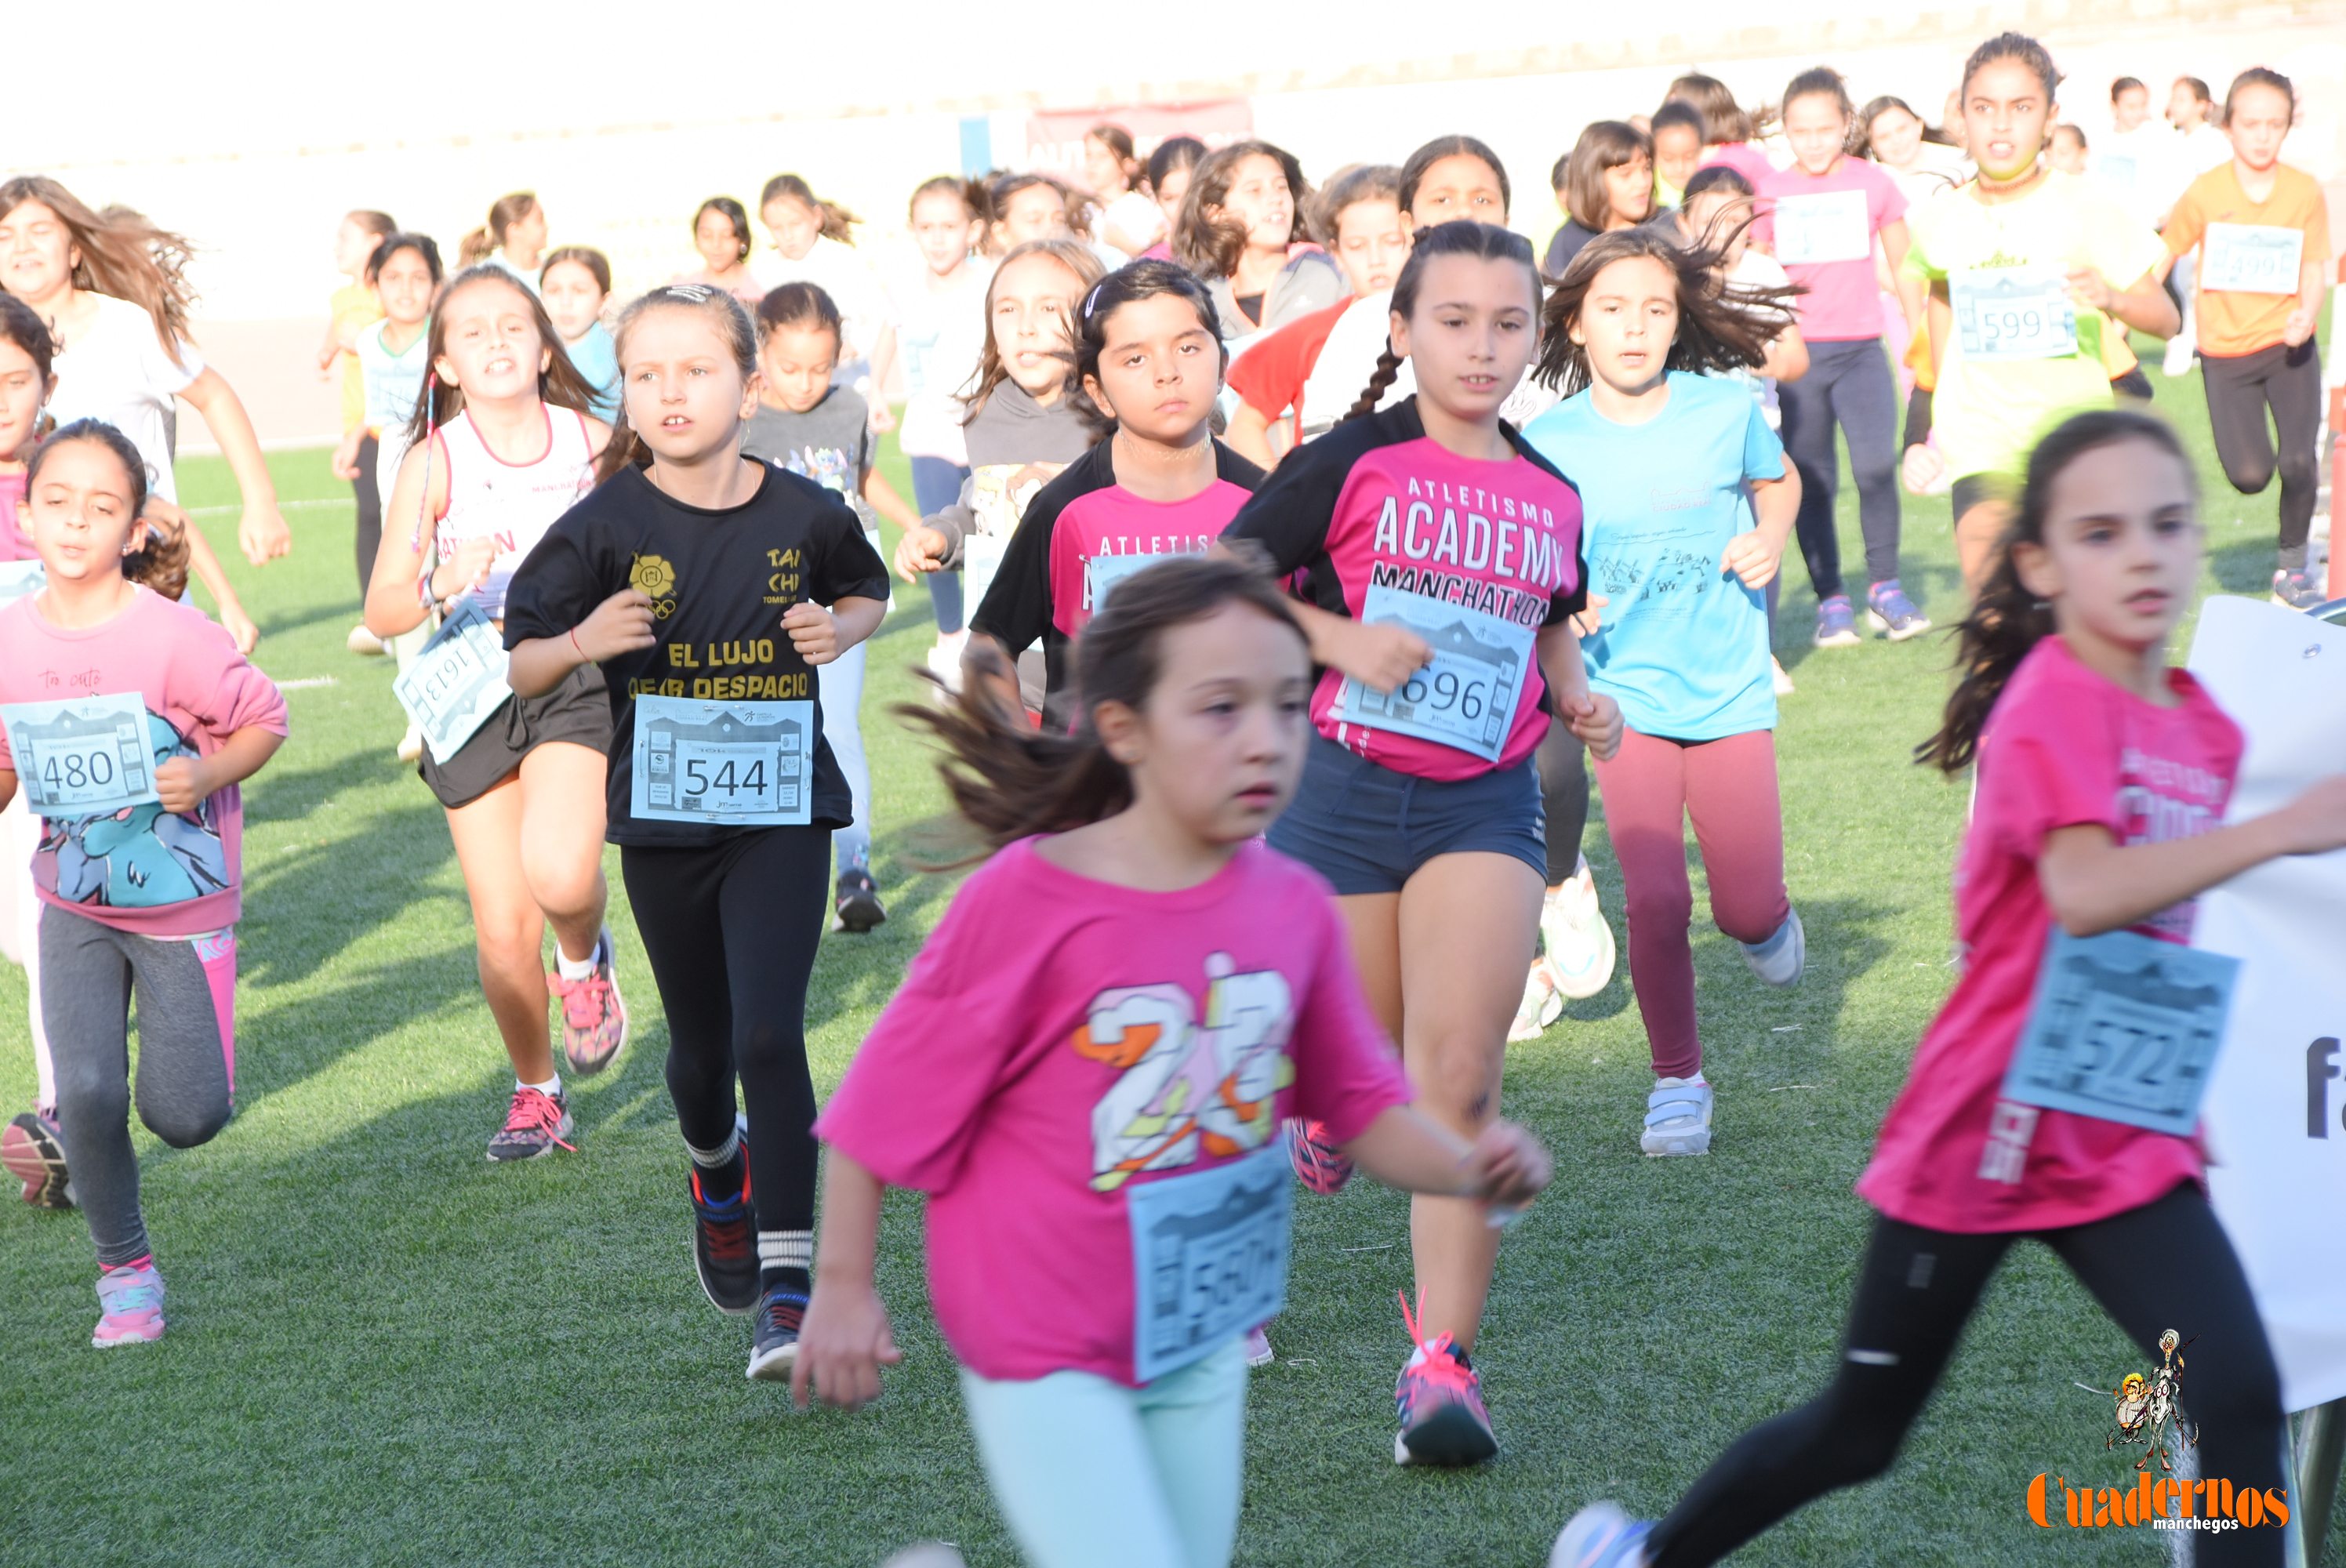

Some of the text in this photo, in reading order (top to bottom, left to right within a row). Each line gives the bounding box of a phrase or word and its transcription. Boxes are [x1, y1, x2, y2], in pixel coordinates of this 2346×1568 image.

[1984, 310, 2041, 340] 599
[1407, 476, 1554, 528] ATLETISMO
[767, 548, 801, 568] TAI
[1373, 495, 1563, 590] ACADEMY
[768, 572, 800, 593] CHI
[668, 638, 774, 667] EL LUJO
[426, 646, 470, 702] 1613
[693, 672, 808, 699] DESPACIO
[1401, 662, 1486, 720] 696
[43, 750, 114, 790] 480
[685, 759, 768, 797] 544
[2076, 1019, 2177, 1087] 572
